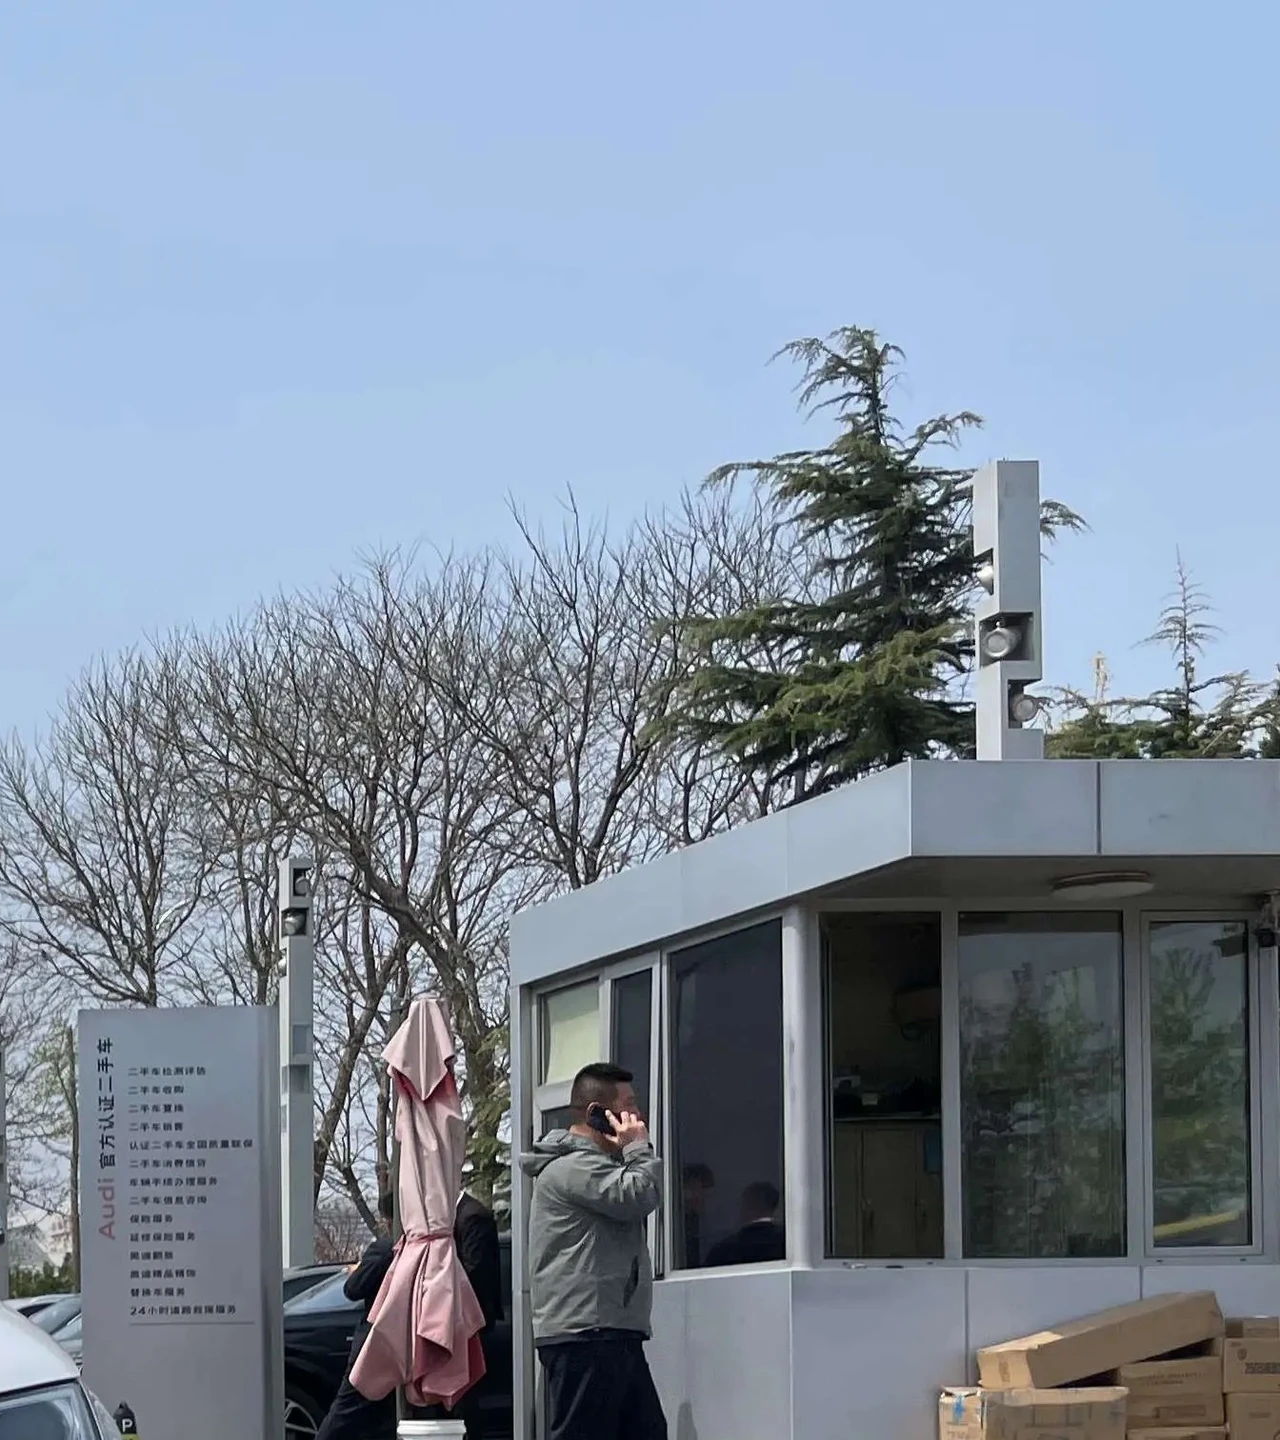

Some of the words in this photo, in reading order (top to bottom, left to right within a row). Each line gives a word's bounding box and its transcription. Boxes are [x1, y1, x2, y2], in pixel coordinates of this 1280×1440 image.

[97, 1037, 116, 1169] 官方认证二手车
[98, 1178, 116, 1240] Audi
[121, 1418, 133, 1433] P
